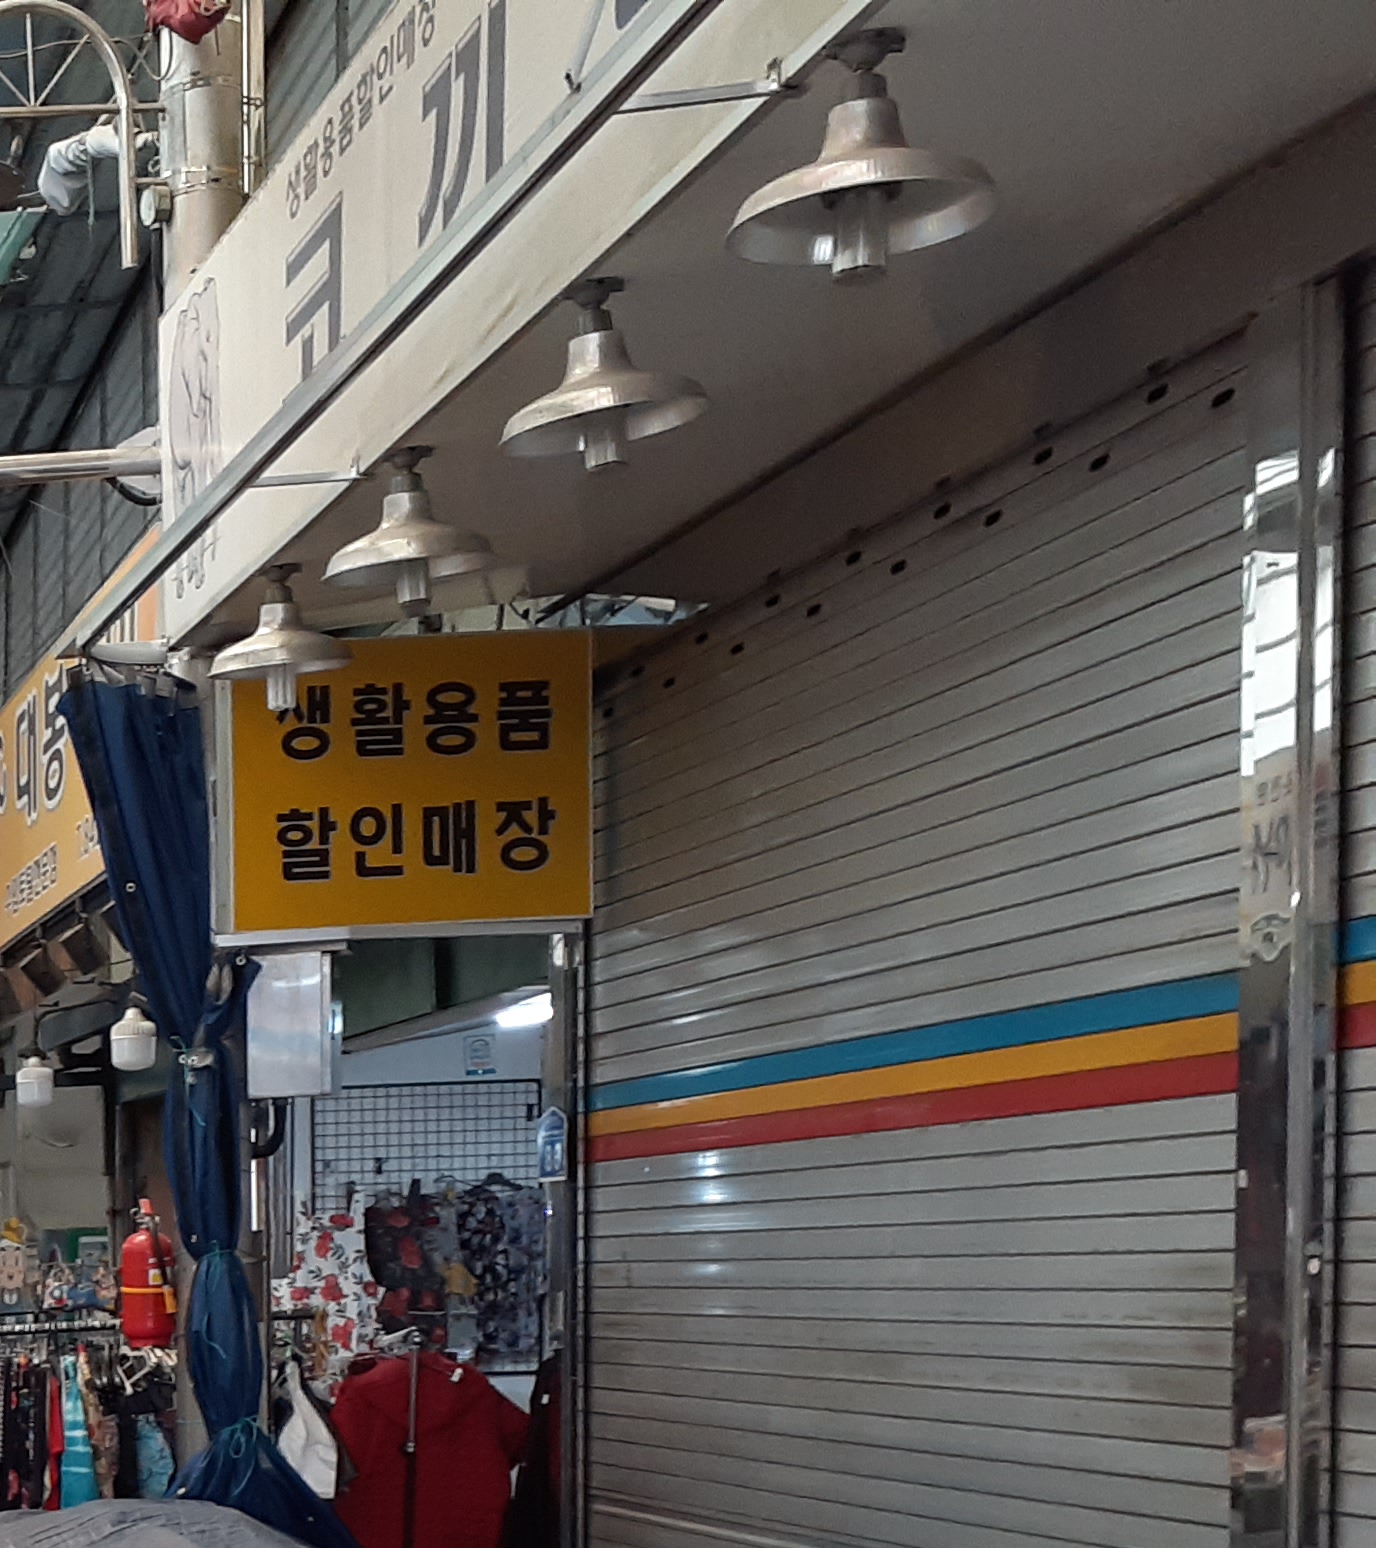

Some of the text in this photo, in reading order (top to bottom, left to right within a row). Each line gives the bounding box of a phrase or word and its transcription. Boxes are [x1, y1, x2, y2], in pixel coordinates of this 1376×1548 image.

[286, 0, 436, 220] 생활용품할인매장
[276, 680, 553, 761] 생활용품
[275, 796, 557, 882] 할인매장
